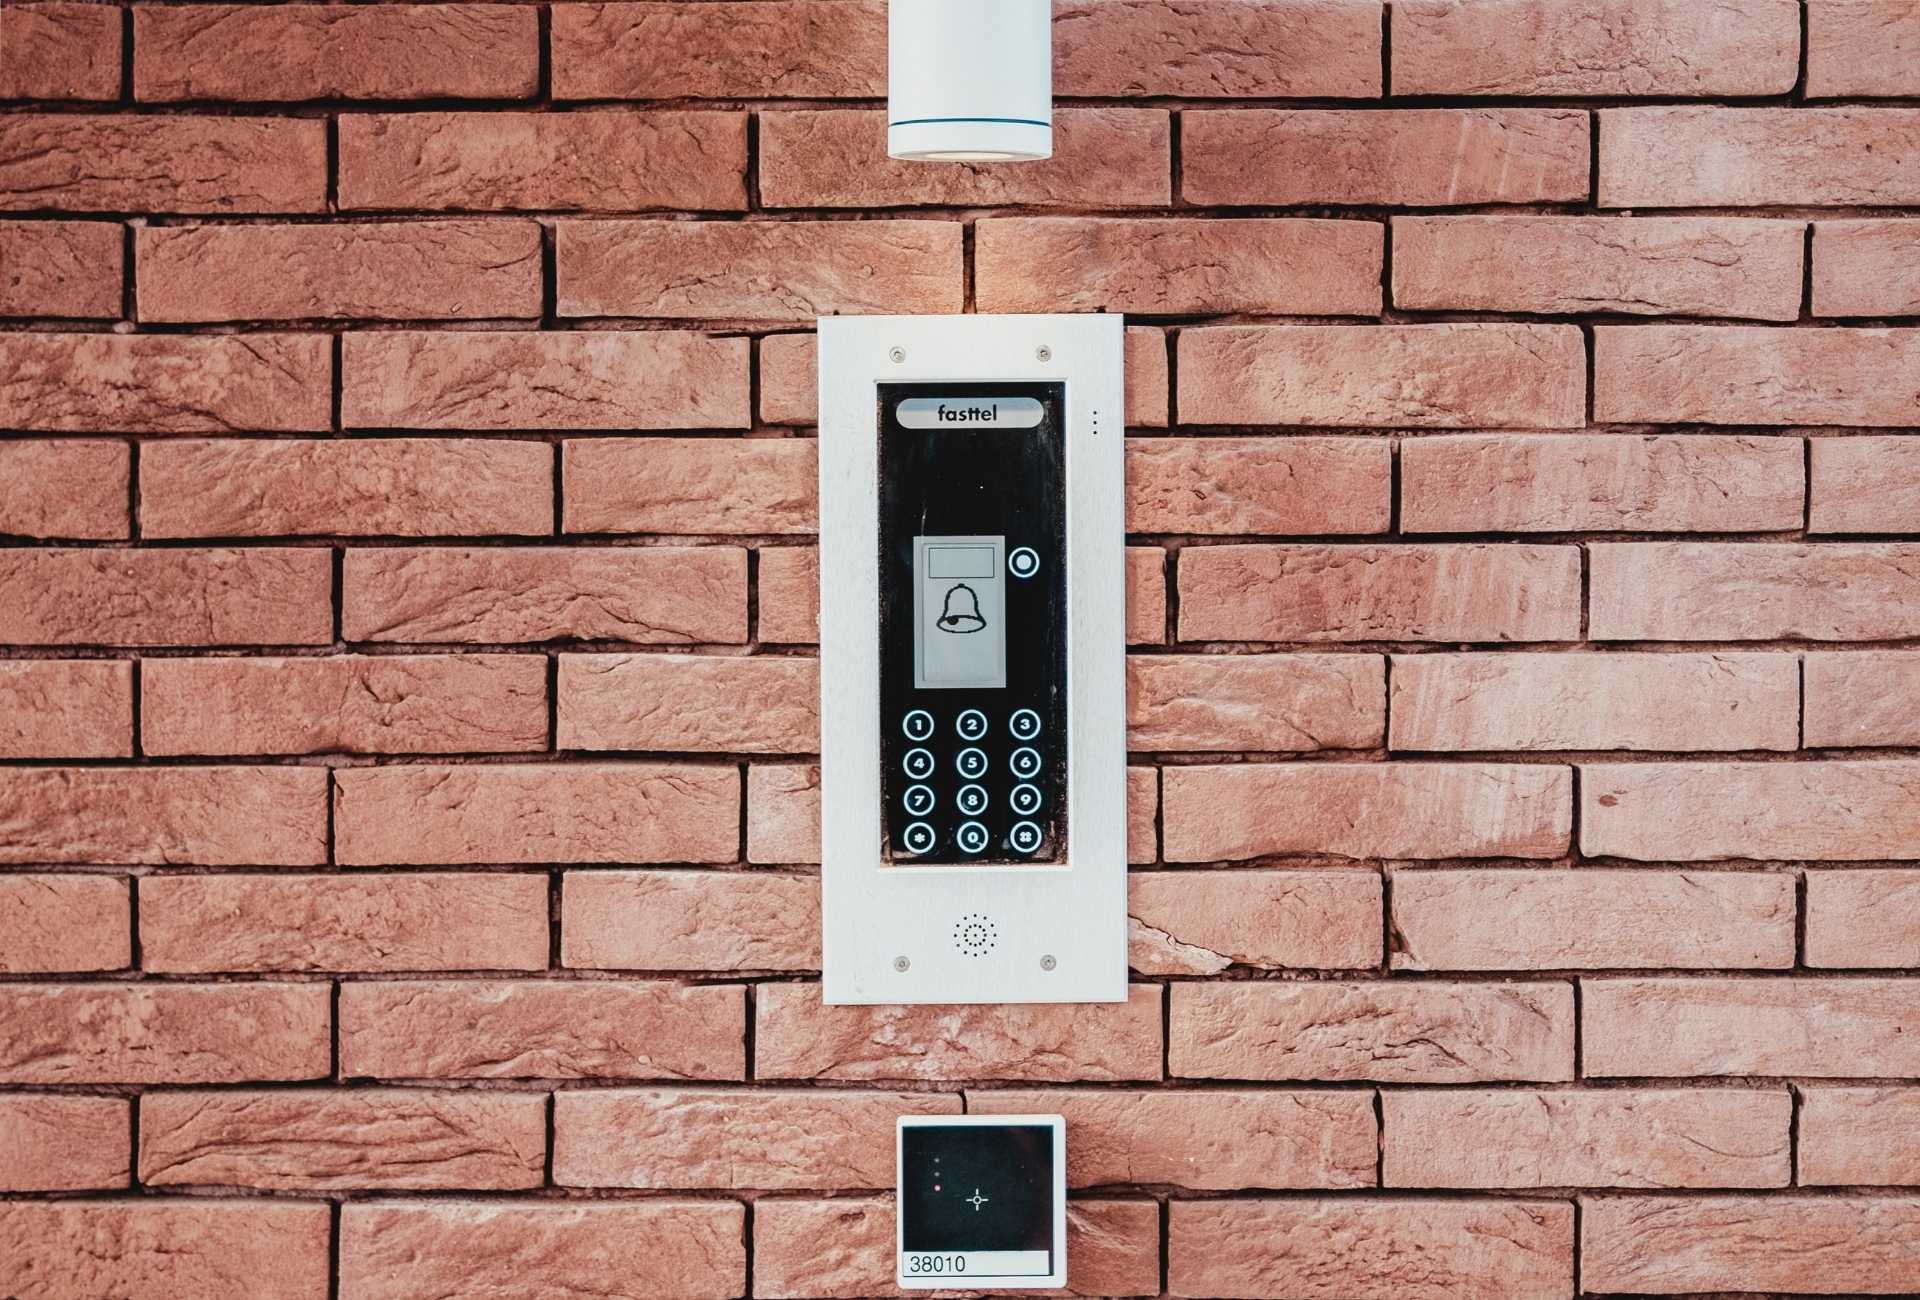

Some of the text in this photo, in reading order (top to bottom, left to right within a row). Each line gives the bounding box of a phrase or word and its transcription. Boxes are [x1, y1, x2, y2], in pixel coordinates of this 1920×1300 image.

[937, 403, 997, 422] fasttel
[914, 718, 1031, 731] 1 2 3
[913, 757, 1032, 769] 4 5 6
[914, 793, 1032, 807] 7 8 9
[967, 831, 979, 844] 0
[910, 1255, 966, 1273] 38010
